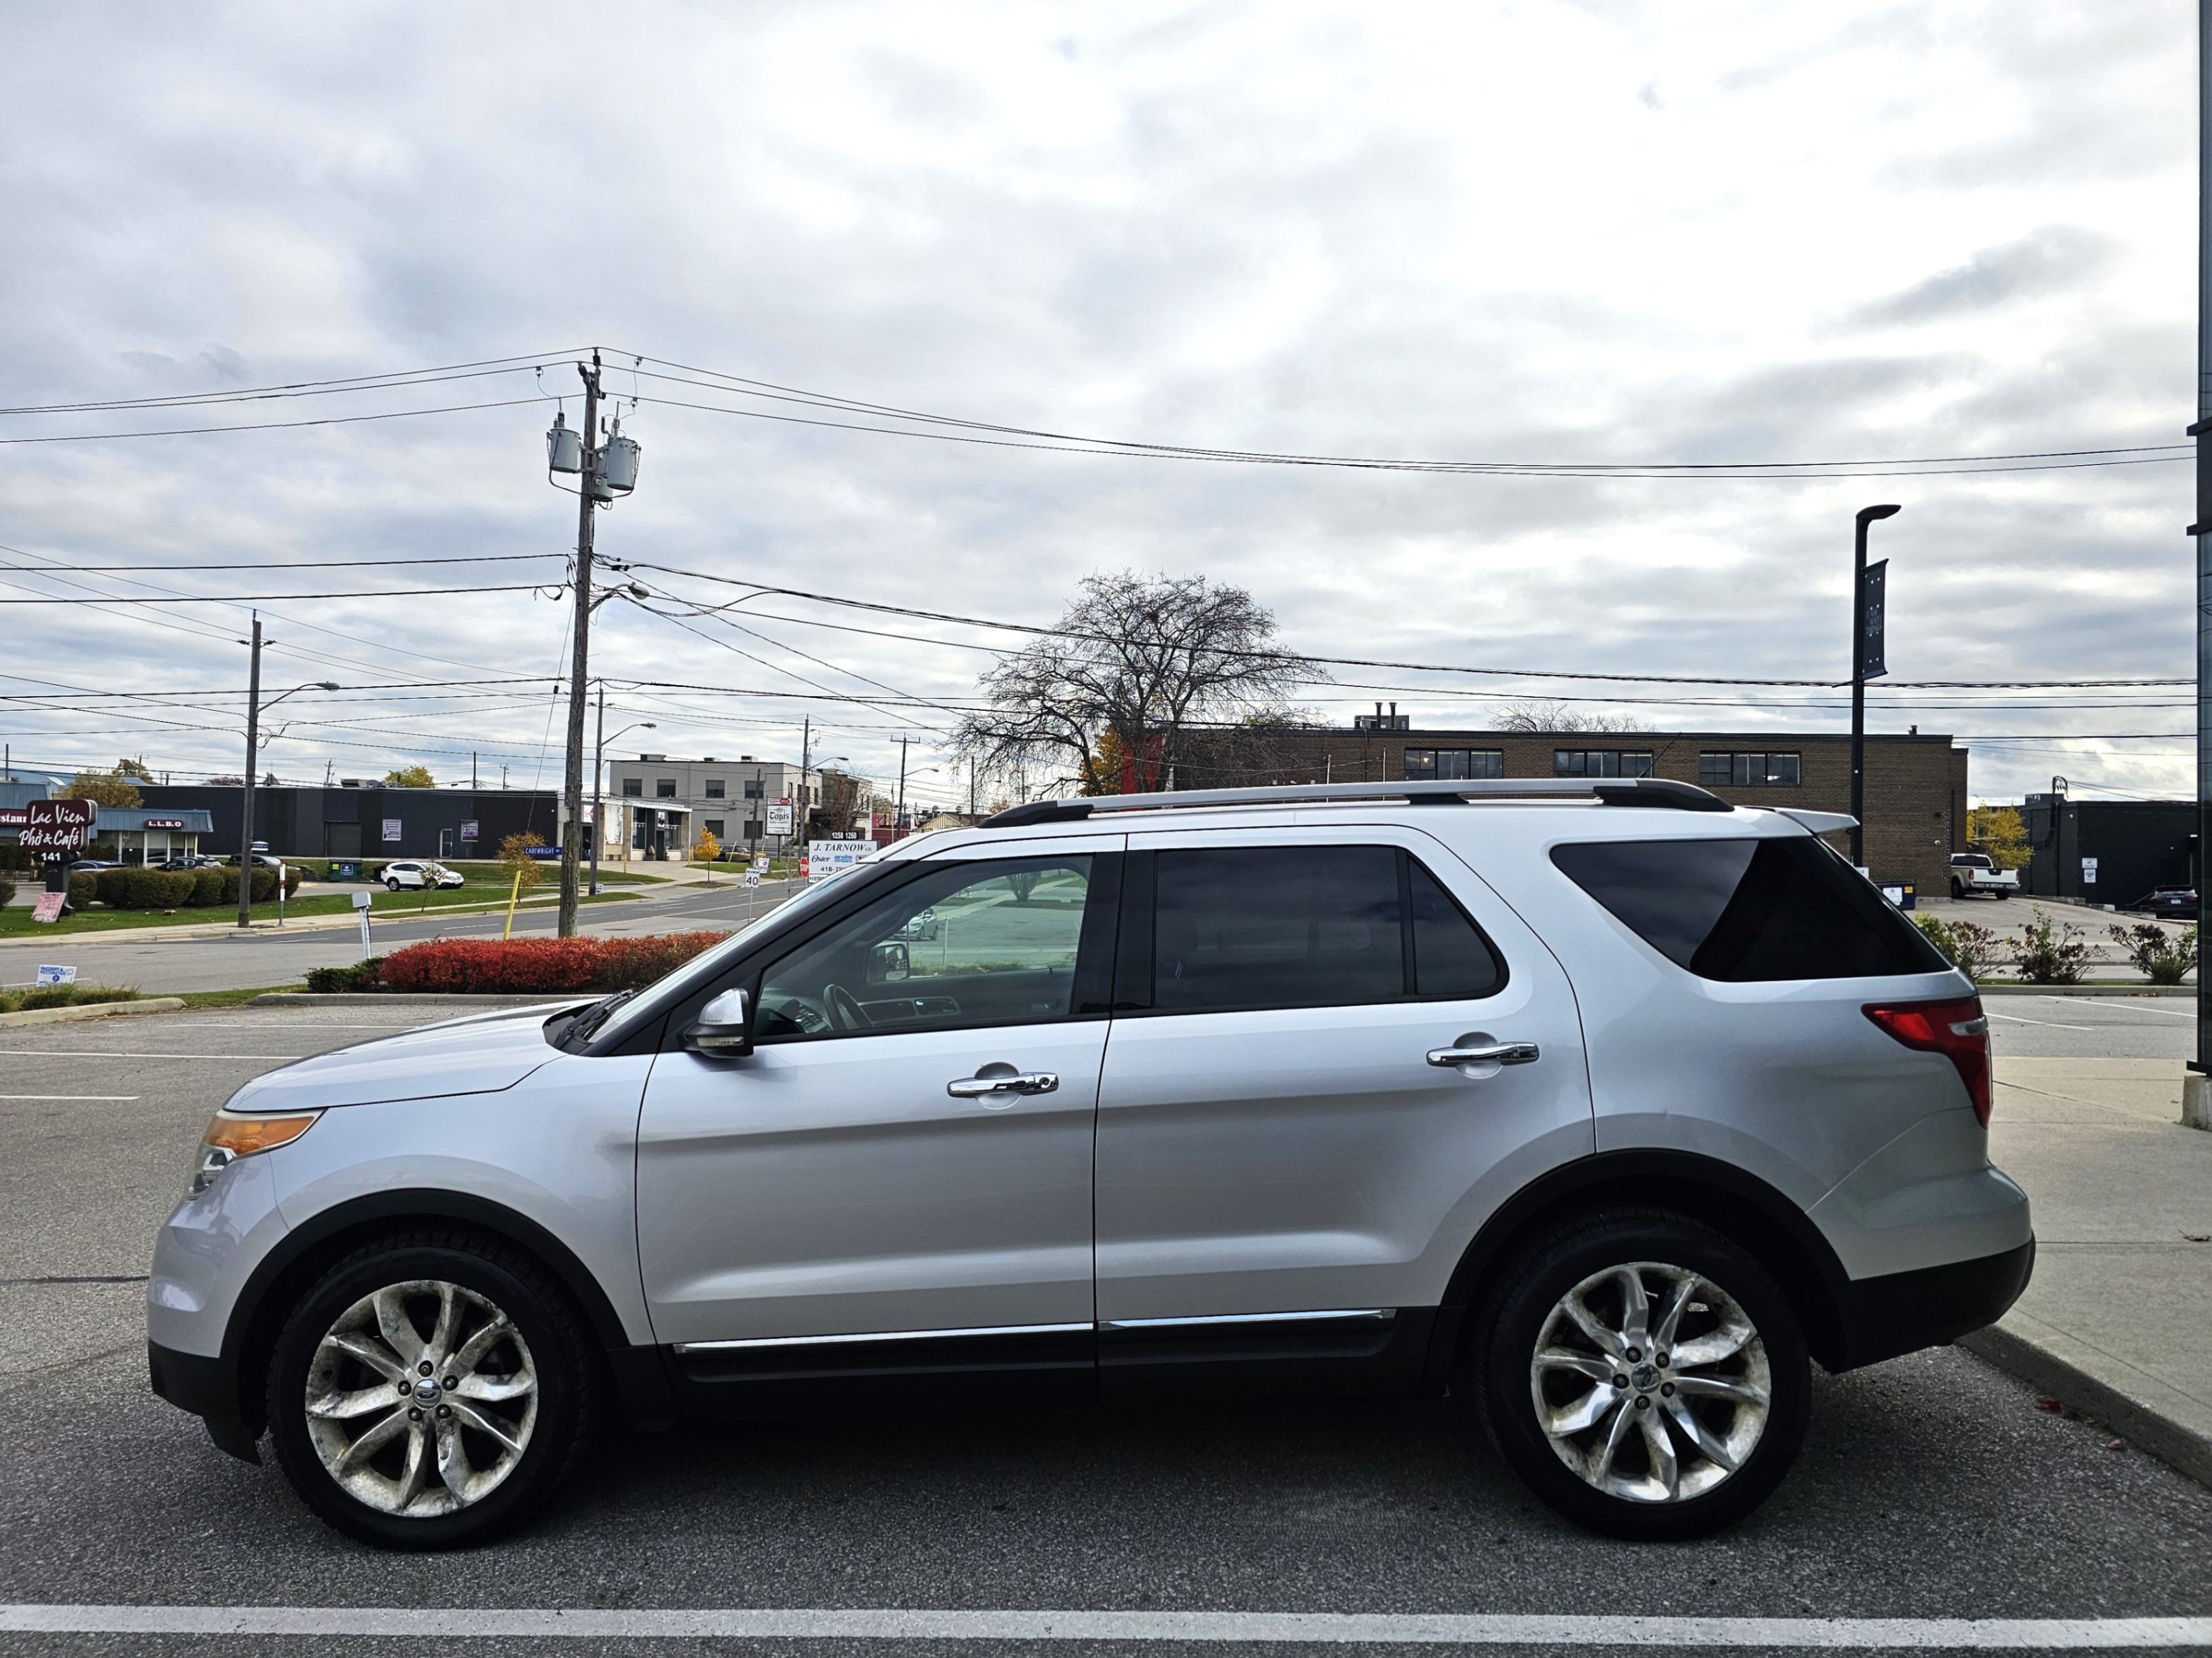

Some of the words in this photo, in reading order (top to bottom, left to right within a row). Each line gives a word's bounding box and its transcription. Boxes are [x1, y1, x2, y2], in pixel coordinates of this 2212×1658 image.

[0, 813, 27, 823] staur
[31, 805, 52, 824] Lac
[56, 804, 85, 824] Vien
[769, 811, 789, 822] Tapis
[43, 832, 52, 845] &
[54, 827, 79, 850] Café
[814, 843, 821, 851] J.
[824, 843, 866, 852] TARNOW
[41, 852, 60, 861] 141
[746, 877, 759, 885] 40
